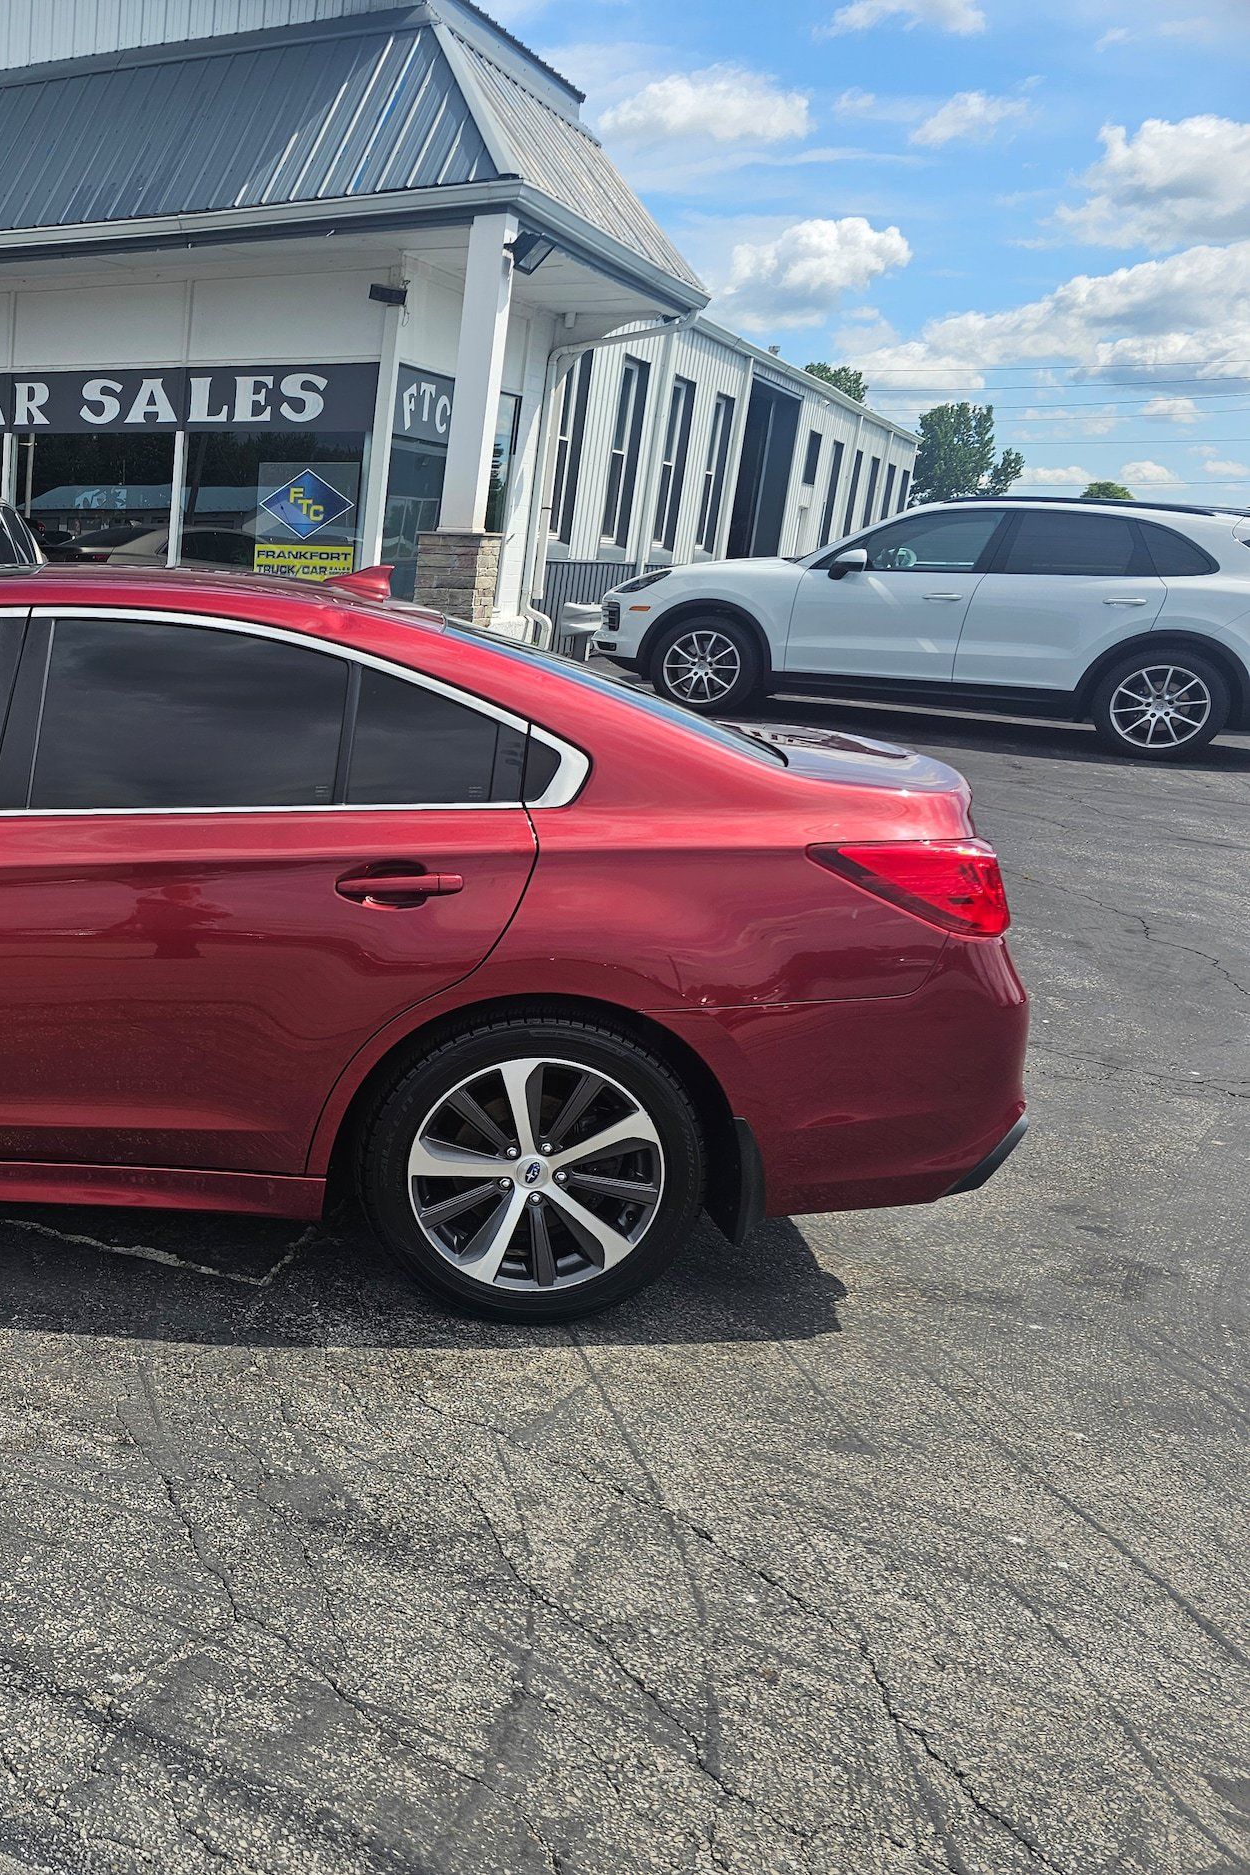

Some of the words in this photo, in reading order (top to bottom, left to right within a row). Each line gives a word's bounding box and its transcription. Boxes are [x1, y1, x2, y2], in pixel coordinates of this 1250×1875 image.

[79, 373, 329, 424] SALES
[403, 381, 451, 433] FTC
[289, 487, 324, 521] FTC
[256, 550, 351, 561] FRANKFORT
[256, 564, 327, 576] TRUCK/CAR
